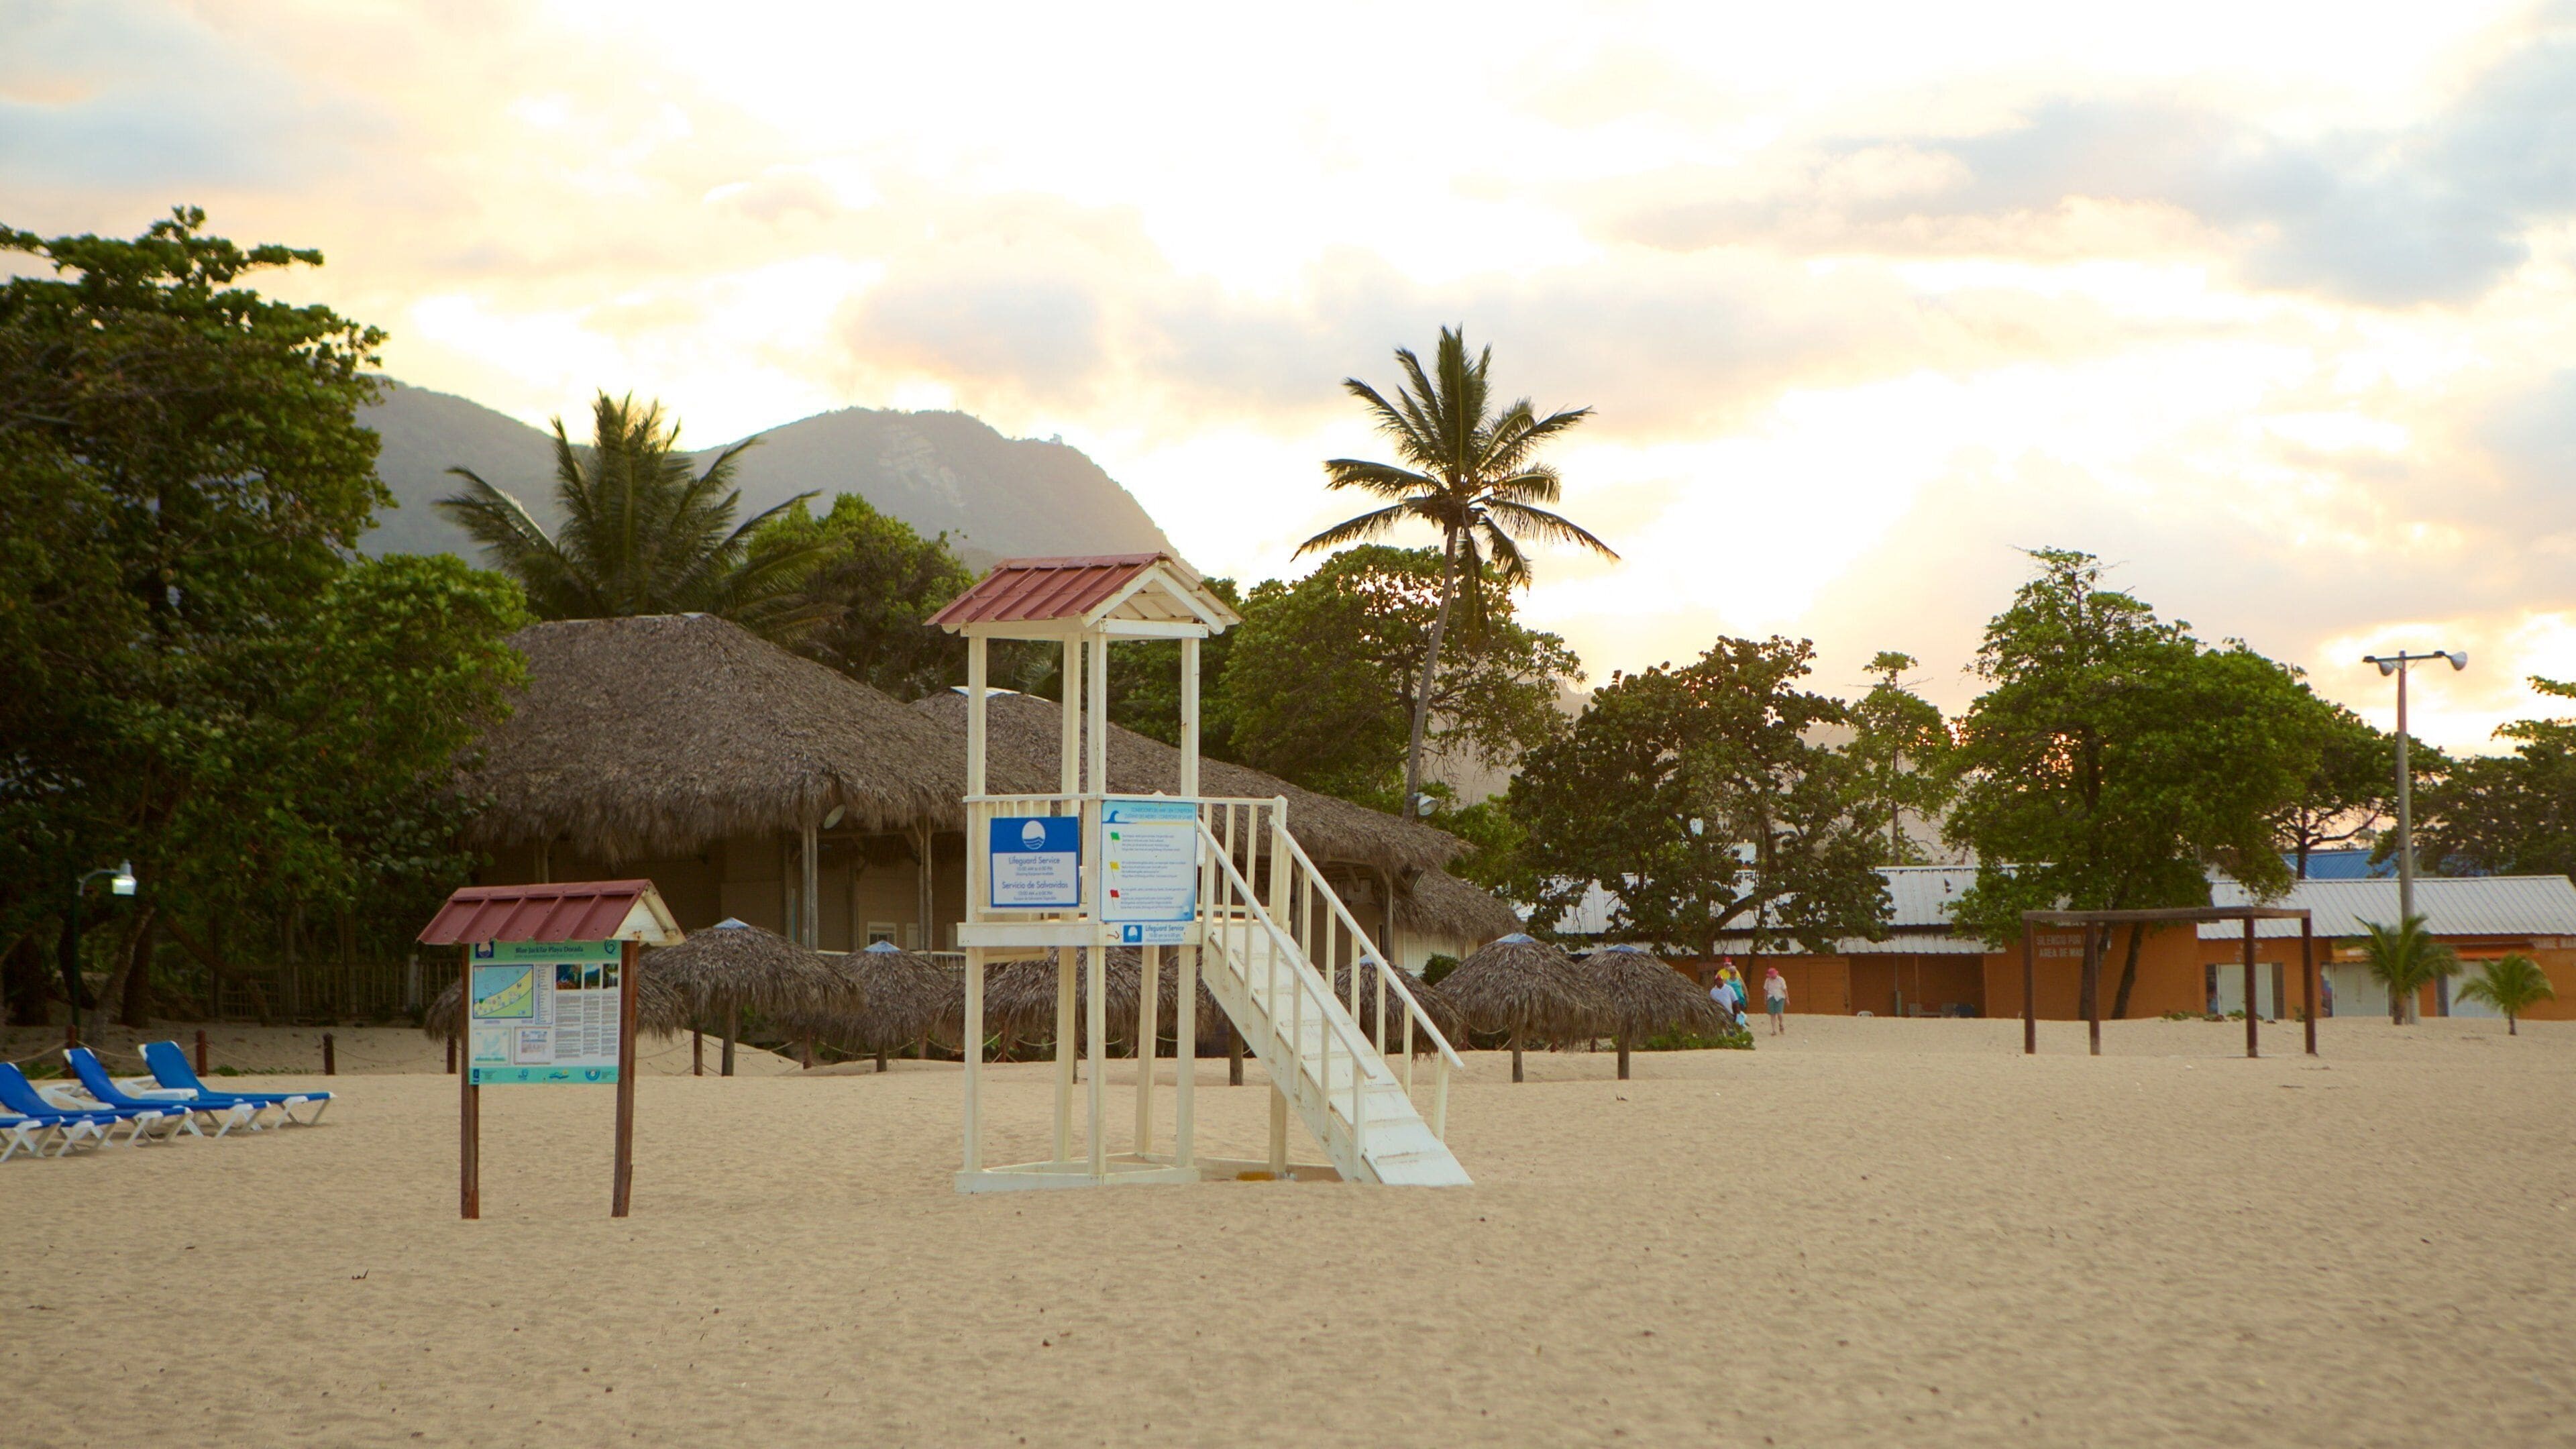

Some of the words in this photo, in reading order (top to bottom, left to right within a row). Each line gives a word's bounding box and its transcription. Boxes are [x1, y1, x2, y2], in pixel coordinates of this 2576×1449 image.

[1008, 856, 1036, 866] Lifeguard
[1038, 856, 1061, 864] Service
[1002, 881, 1026, 889] Servicio
[1027, 880, 1035, 889] de
[1036, 880, 1069, 889] Salvavidas
[1146, 924, 1167, 932] Lifeguard
[2036, 934, 2067, 945] SILENCIO
[549, 946, 562, 954] Playa
